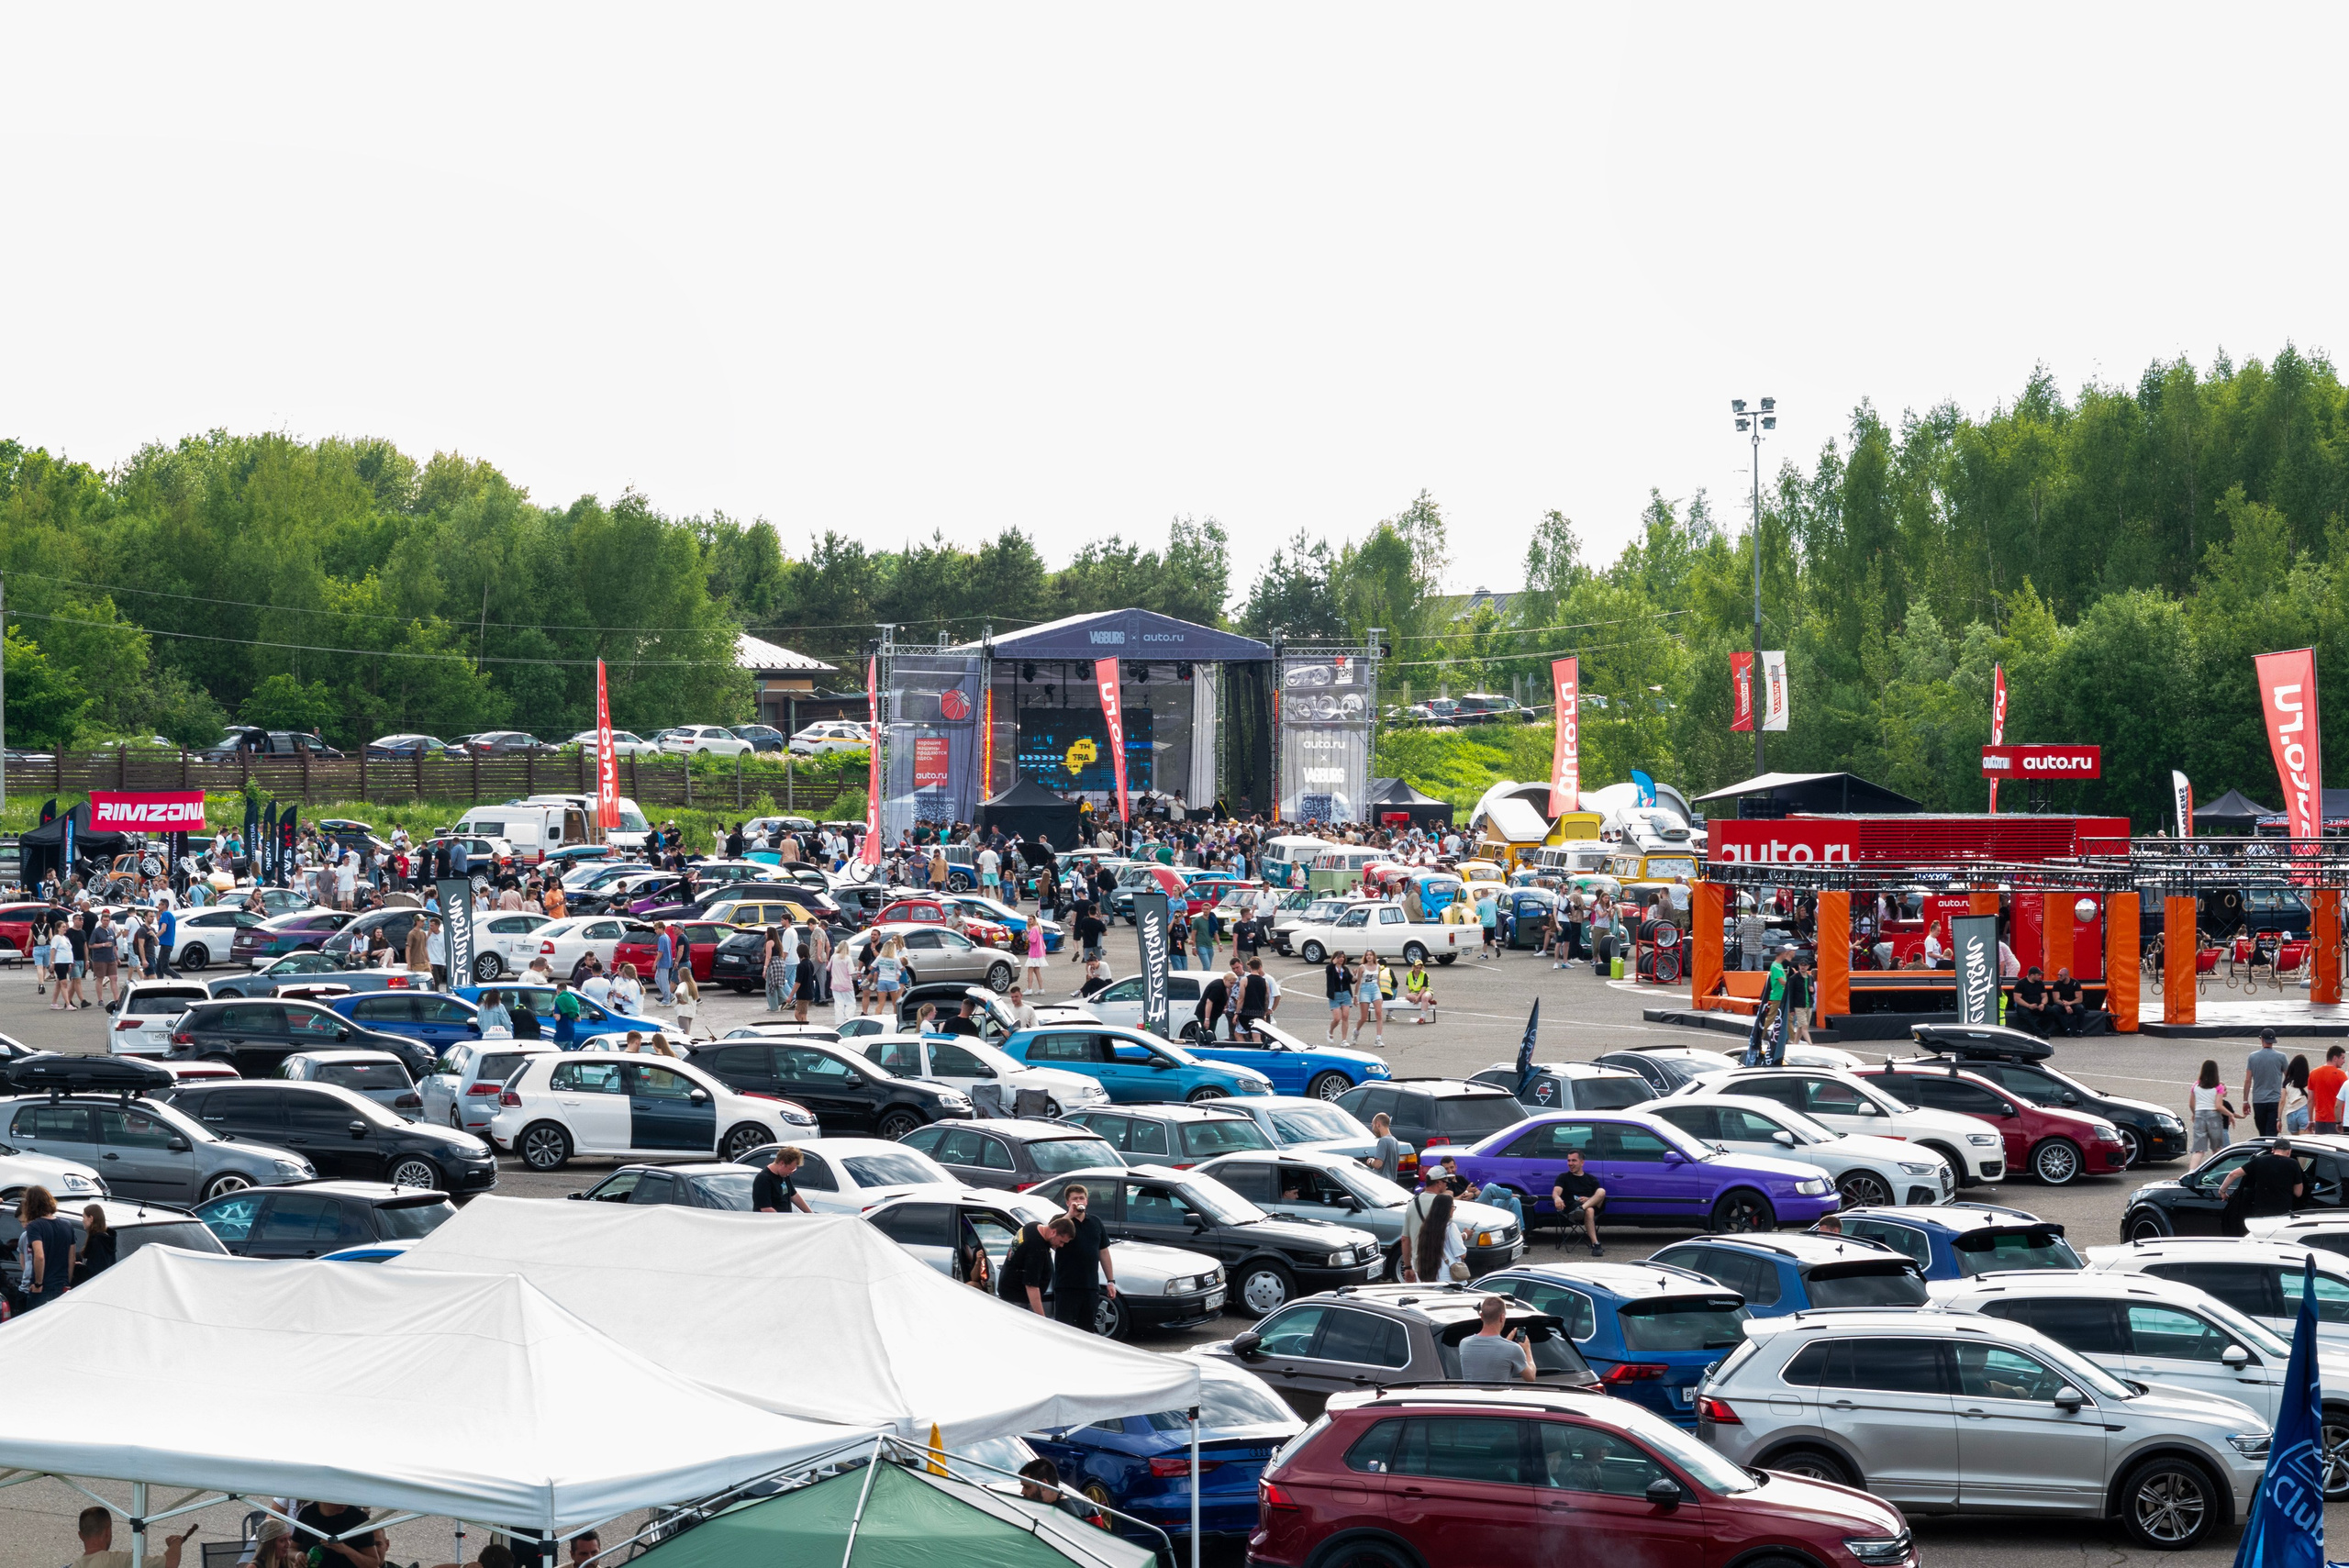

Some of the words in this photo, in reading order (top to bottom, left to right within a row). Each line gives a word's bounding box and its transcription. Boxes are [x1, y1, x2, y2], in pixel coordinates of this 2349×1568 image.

[1089, 631, 1125, 644] VAGBURG
[1143, 632, 1184, 642] auto.ru
[1303, 740, 1345, 749] auto.ru
[1982, 755, 2010, 769] auto.ru
[2023, 755, 2092, 769] auto.ru
[1303, 767, 1345, 783] VAGBURG
[97, 802, 205, 822] RIMZONA
